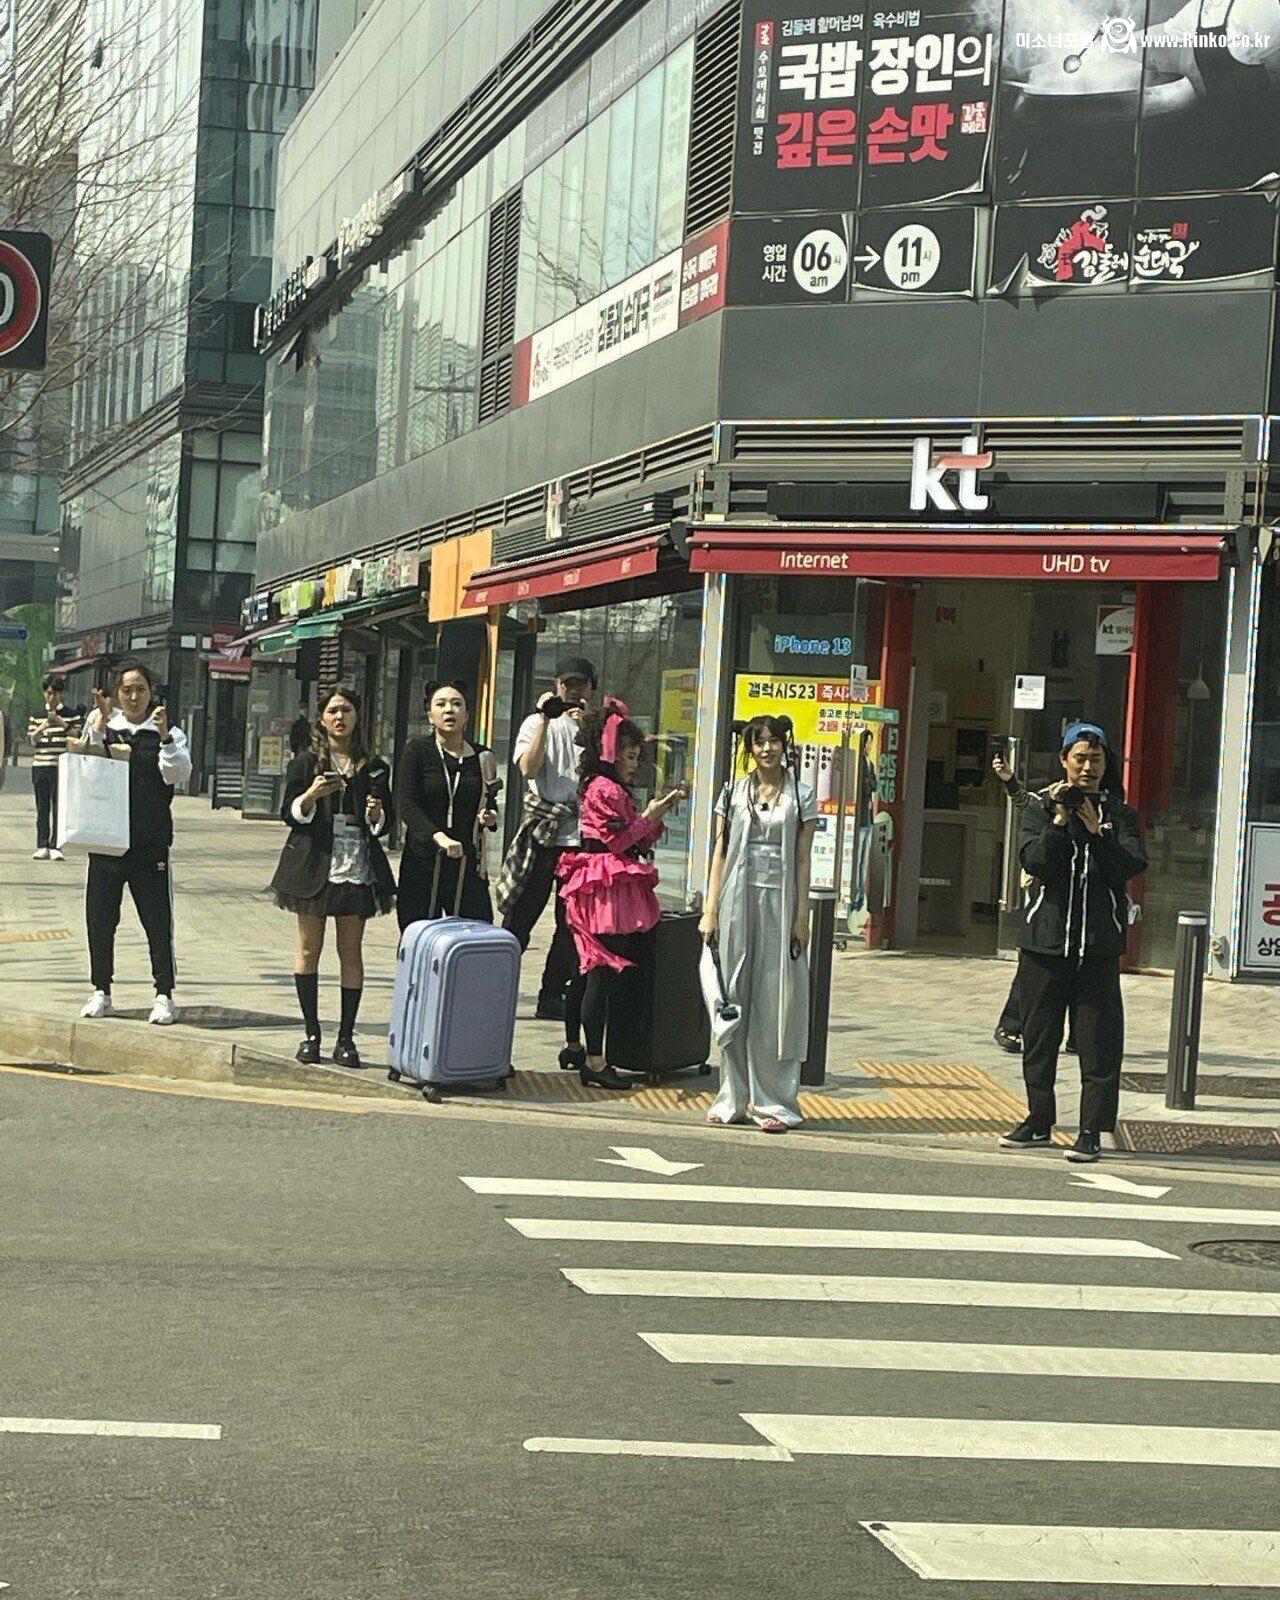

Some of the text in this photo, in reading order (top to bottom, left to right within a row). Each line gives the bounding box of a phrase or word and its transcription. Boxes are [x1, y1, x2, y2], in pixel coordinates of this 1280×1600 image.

[782, 18, 815, 37] 김둘레
[873, 10, 920, 29] 육수비법
[778, 33, 994, 100] 국밥 장인의
[775, 103, 954, 169] 깊은 손맛
[763, 244, 787, 262] 영업
[1133, 240, 1200, 279] 순대국
[762, 264, 787, 283] 시간
[810, 275, 828, 287] am
[901, 271, 920, 285] pm
[910, 436, 994, 511] kt
[780, 551, 1111, 574] Internet UHD tv
[774, 634, 852, 656] iPhone 13
[748, 682, 816, 700] 갤럭시S23
